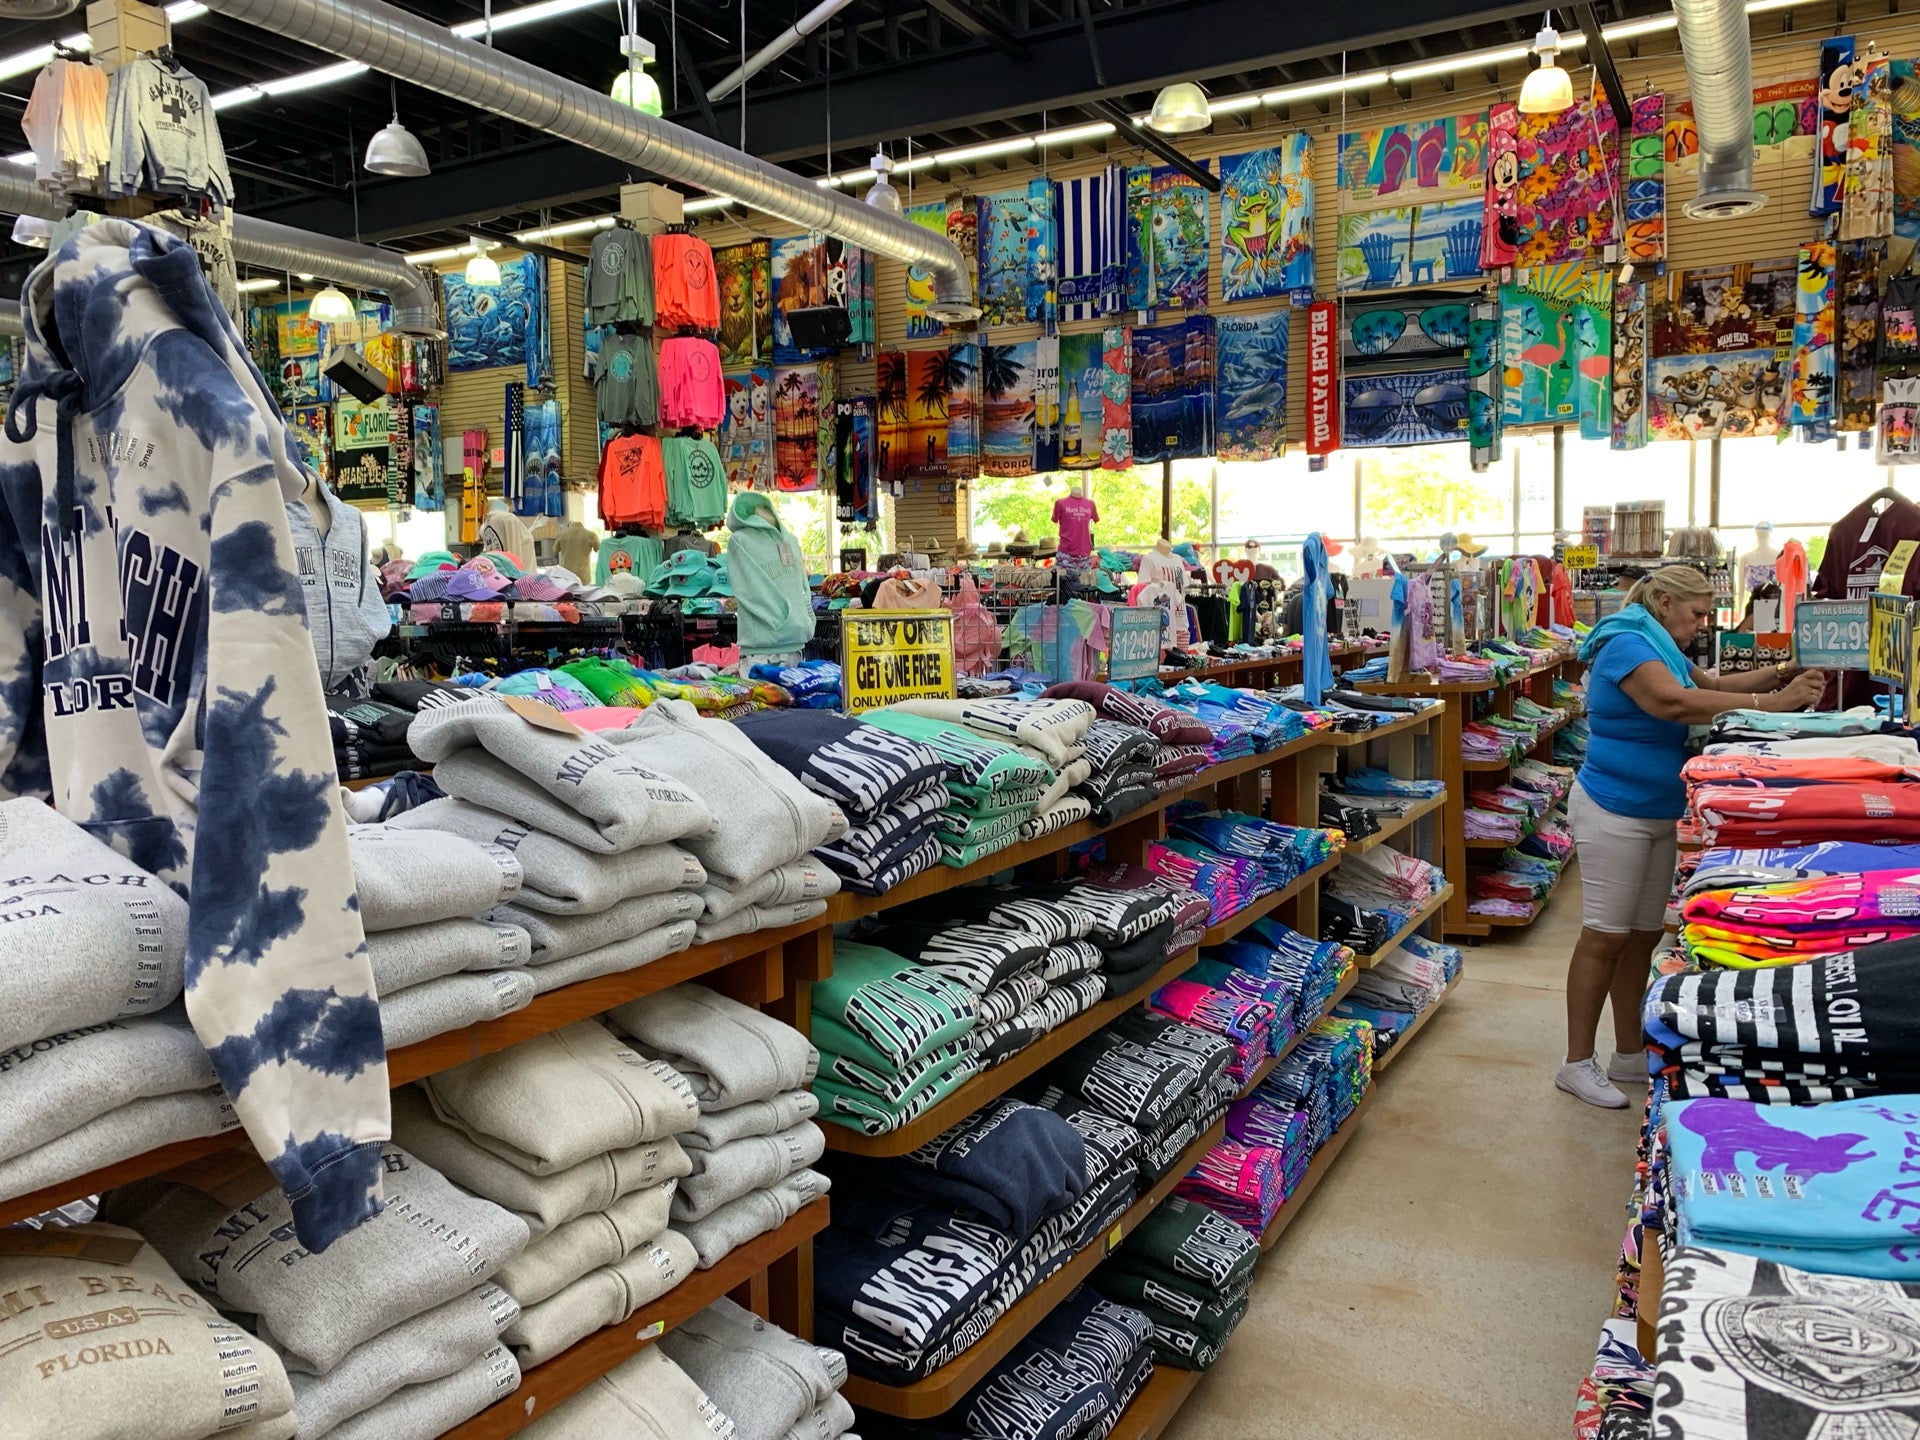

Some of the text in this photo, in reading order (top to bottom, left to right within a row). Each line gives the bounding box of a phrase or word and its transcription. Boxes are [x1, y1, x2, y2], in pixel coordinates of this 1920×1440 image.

[1789, 83, 1815, 94] BEACH
[175, 84, 201, 114] PATROL
[200, 239, 225, 269] PATROL
[1059, 294, 1084, 304] MIAMI
[1517, 286, 1574, 309] Sunshine
[1221, 322, 1258, 332] FLORIDA
[1311, 309, 1328, 369] BEACH
[1717, 332, 1749, 347] MIAMI BEACH
[1312, 374, 1330, 448] PATROL
[139, 443, 156, 468] Small
[1217, 562, 1251, 583] ty
[1838, 604, 1864, 615] Island
[858, 620, 943, 647] BUY ONE
[1114, 630, 1157, 661] $12.99
[857, 655, 881, 690] GET
[885, 654, 910, 689] ONE
[912, 653, 941, 687] FREE
[853, 696, 882, 708] ONLY
[1031, 701, 1092, 731] FLORIDA
[646, 788, 694, 803] FLORIDA
[972, 807, 1029, 844] FLORIDA
[503, 871, 518, 879] Small
[123, 900, 153, 908] Small
[1883, 907, 1919, 916] XX-Large
[130, 912, 159, 920] Small
[135, 926, 162, 936] Small
[498, 930, 517, 938] Small
[138, 943, 163, 953] Small
[501, 945, 518, 953] Small
[137, 961, 162, 971] Small
[135, 980, 159, 989] Small
[492, 975, 510, 988] Small
[500, 987, 517, 999] Small
[126, 997, 151, 1005] Small
[1825, 988, 1869, 1054] LOYAL
[1149, 1119, 1197, 1170] FLORIDA
[645, 1149, 657, 1158] Large
[645, 1162, 656, 1171] Large
[798, 1182, 816, 1193] Medium
[1701, 1172, 1719, 1195] Small
[1727, 1173, 1747, 1197] Small
[1755, 1175, 1776, 1199] Small
[1783, 1174, 1805, 1200] Small
[442, 1229, 458, 1242] Large
[454, 1236, 471, 1252] Large
[464, 1246, 480, 1264] Large
[470, 1259, 487, 1277] Large
[663, 1269, 675, 1280] Large
[488, 1296, 510, 1313] Medium
[495, 1306, 519, 1326] Medium
[213, 1334, 244, 1344] Medium
[36, 1337, 174, 1380] FLORIDA
[218, 1347, 252, 1360] Medium
[483, 1346, 502, 1360] Large
[223, 1362, 258, 1378] Medium
[490, 1358, 510, 1373] Large
[827, 1357, 843, 1370] Medium
[495, 1373, 515, 1388] Large
[830, 1367, 846, 1380] Medium
[224, 1382, 259, 1398] Medium
[223, 1401, 258, 1417] Medium
